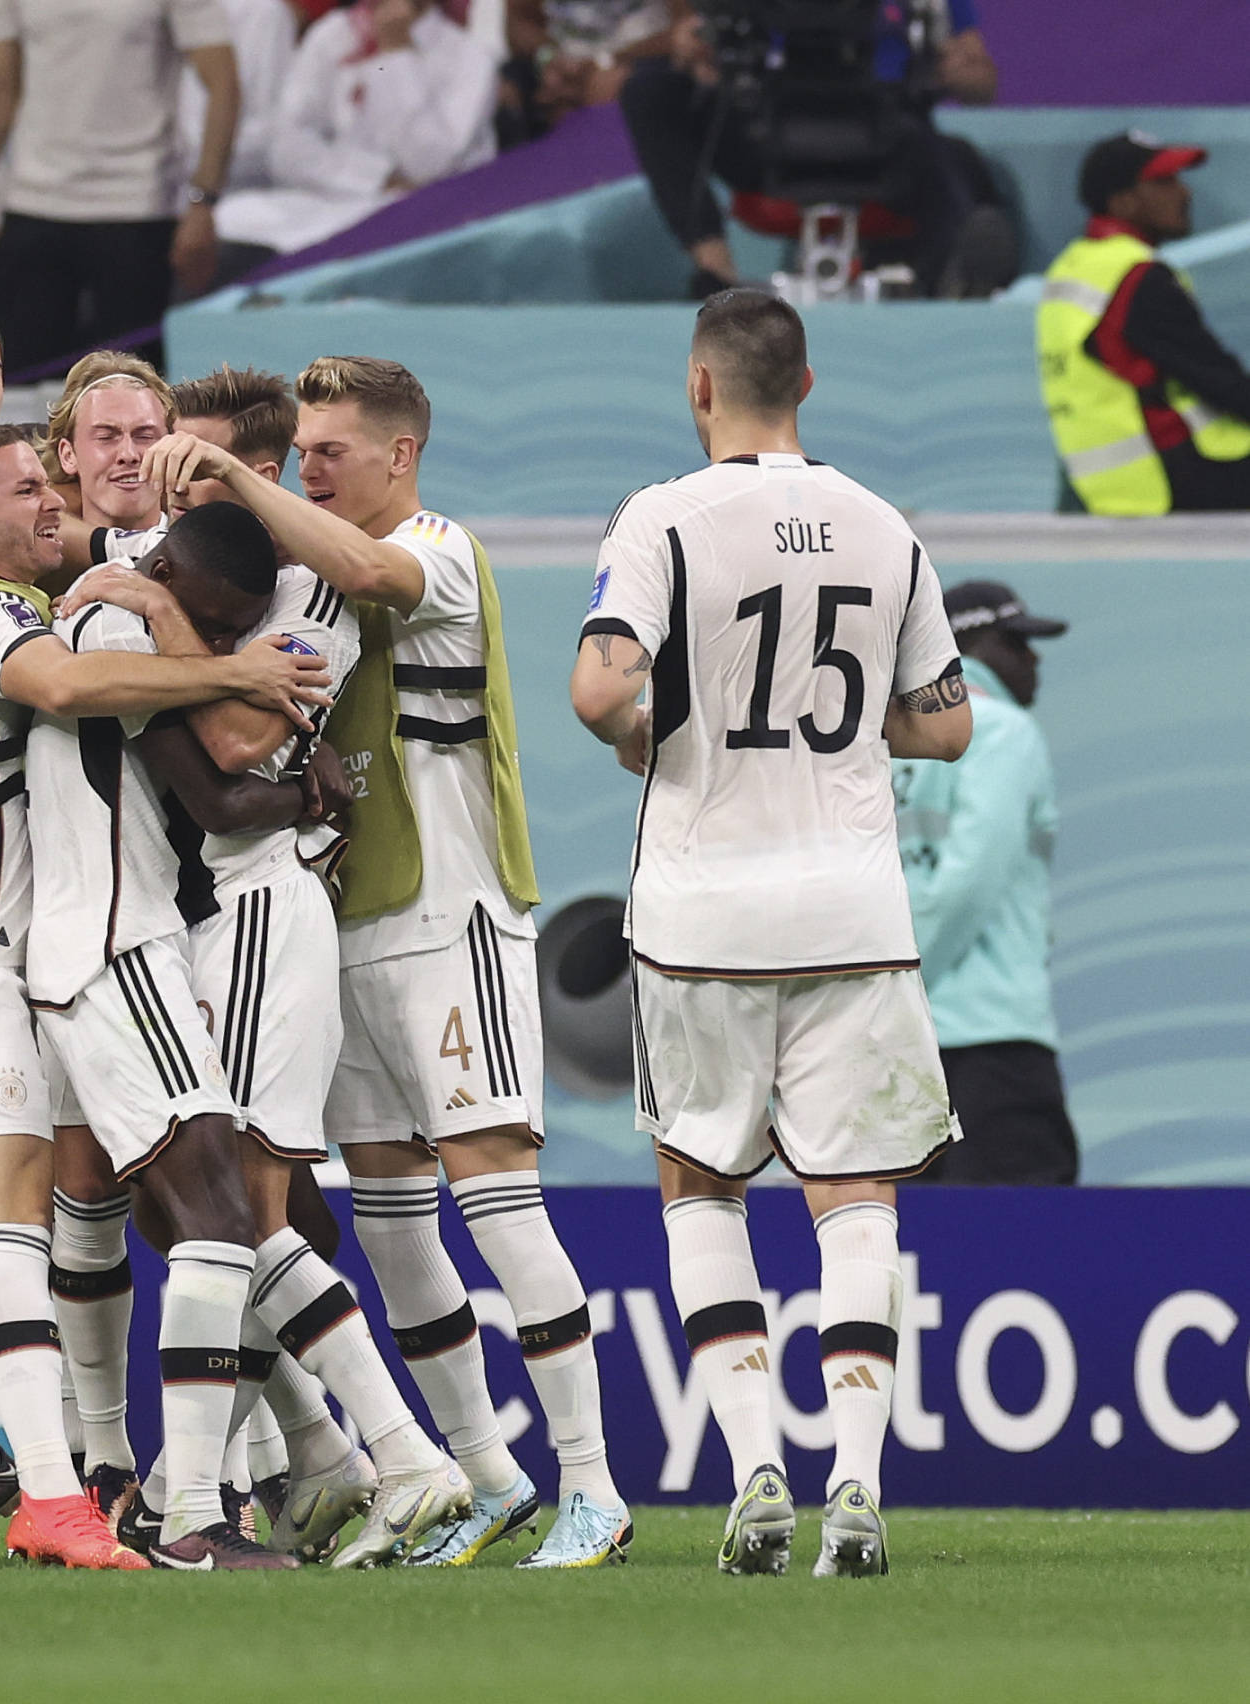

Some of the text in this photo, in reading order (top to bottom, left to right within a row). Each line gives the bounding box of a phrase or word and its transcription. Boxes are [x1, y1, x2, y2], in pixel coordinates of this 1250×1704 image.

[774, 516, 834, 553] SÜLE
[726, 583, 872, 754] 15
[342, 750, 373, 774] CUP
[439, 1006, 473, 1071] 4
[450, 1250, 1250, 1492] cypto.c
